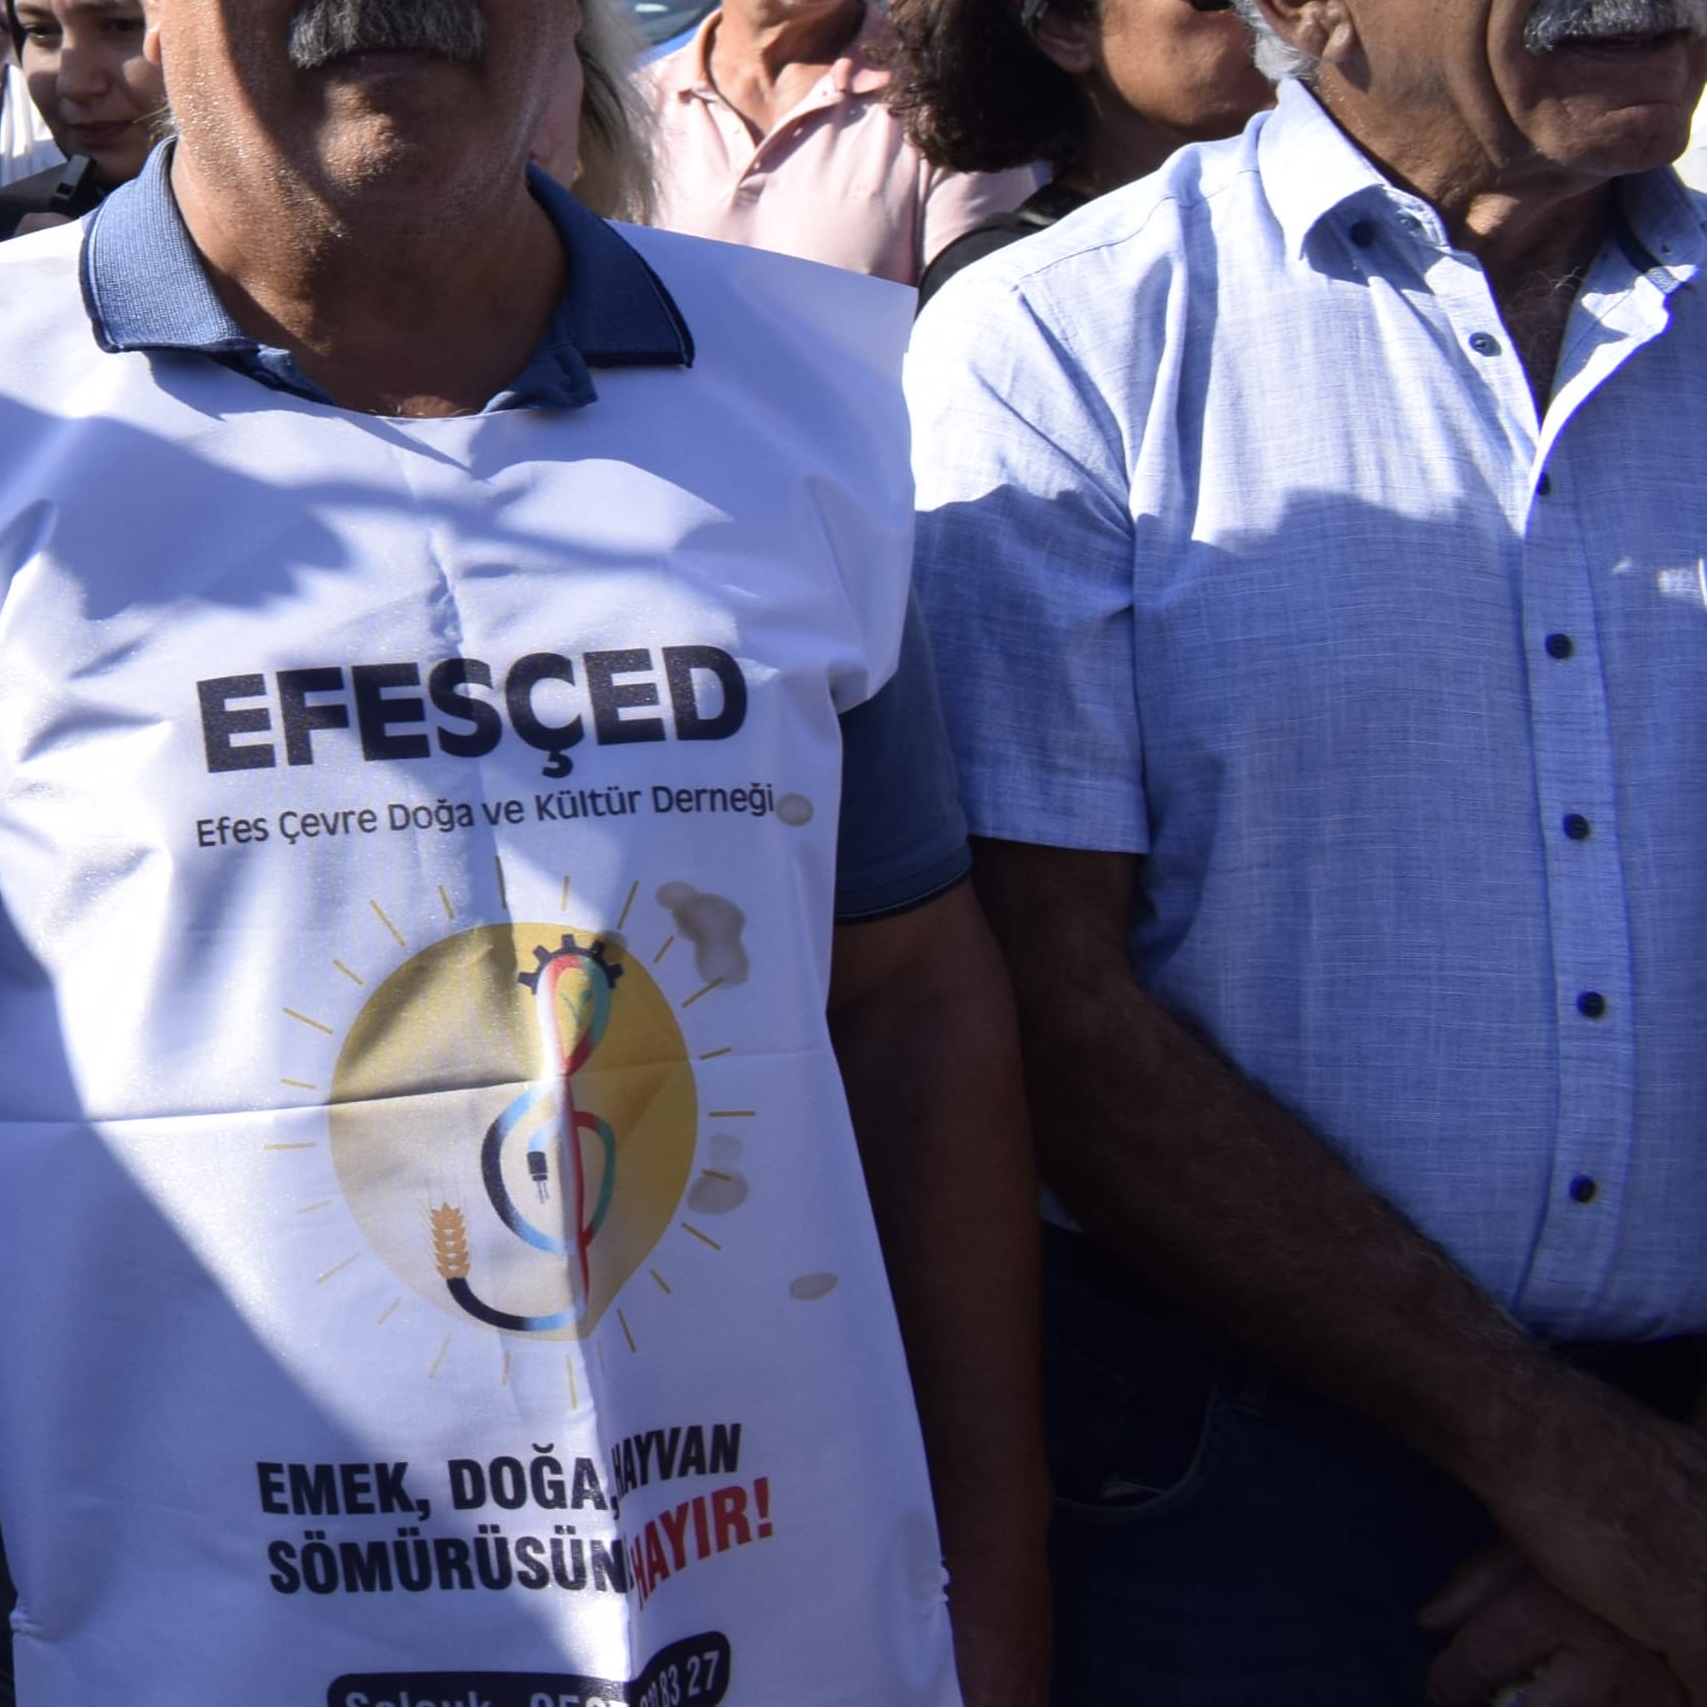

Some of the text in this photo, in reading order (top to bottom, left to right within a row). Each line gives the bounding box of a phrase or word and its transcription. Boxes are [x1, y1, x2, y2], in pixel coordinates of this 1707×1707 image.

[197, 645, 748, 778] EFESÇED
[197, 782, 775, 847] Efes Çevre Doğa ve Kültür Derneği
[256, 1423, 742, 1521] EMEK, DOĞA, HAYVAN
[267, 1477, 773, 1612] SÖMÜRÜSÜN HAYIR!
